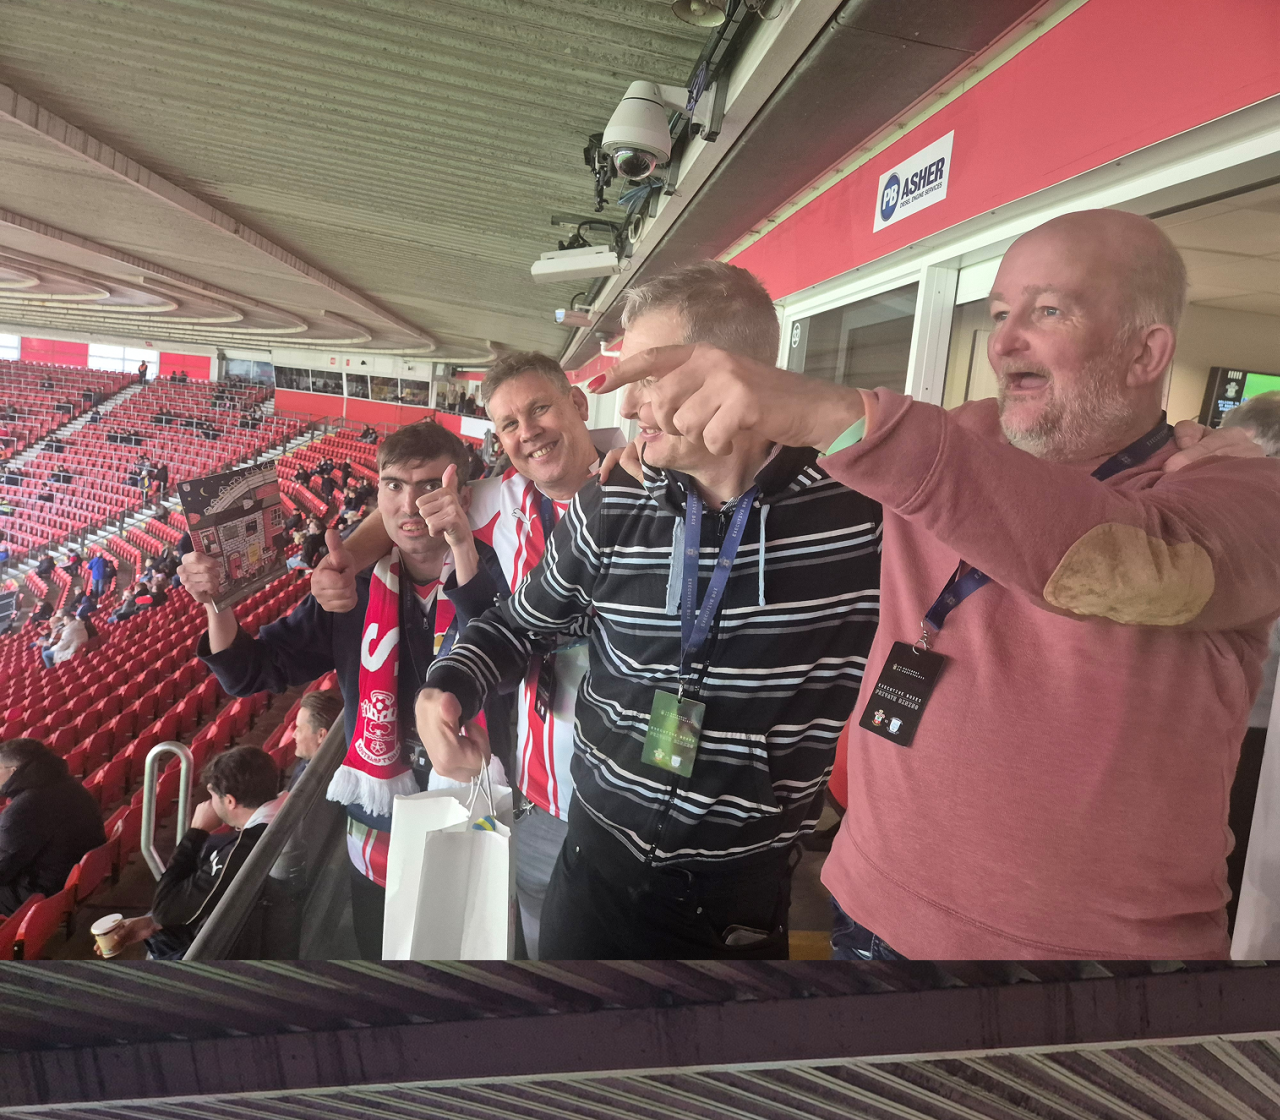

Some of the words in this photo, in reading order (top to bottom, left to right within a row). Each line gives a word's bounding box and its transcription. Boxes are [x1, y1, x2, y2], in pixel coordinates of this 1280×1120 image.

[882, 184, 899, 210] PB
[901, 157, 945, 200] ASHER
[900, 198, 911, 208] DIESEL
[911, 191, 925, 202] ENGINE
[925, 182, 943, 196] SERVICES
[732, 509, 745, 538] EXECUTIVE
[700, 599, 714, 627] EXECUTIVE
